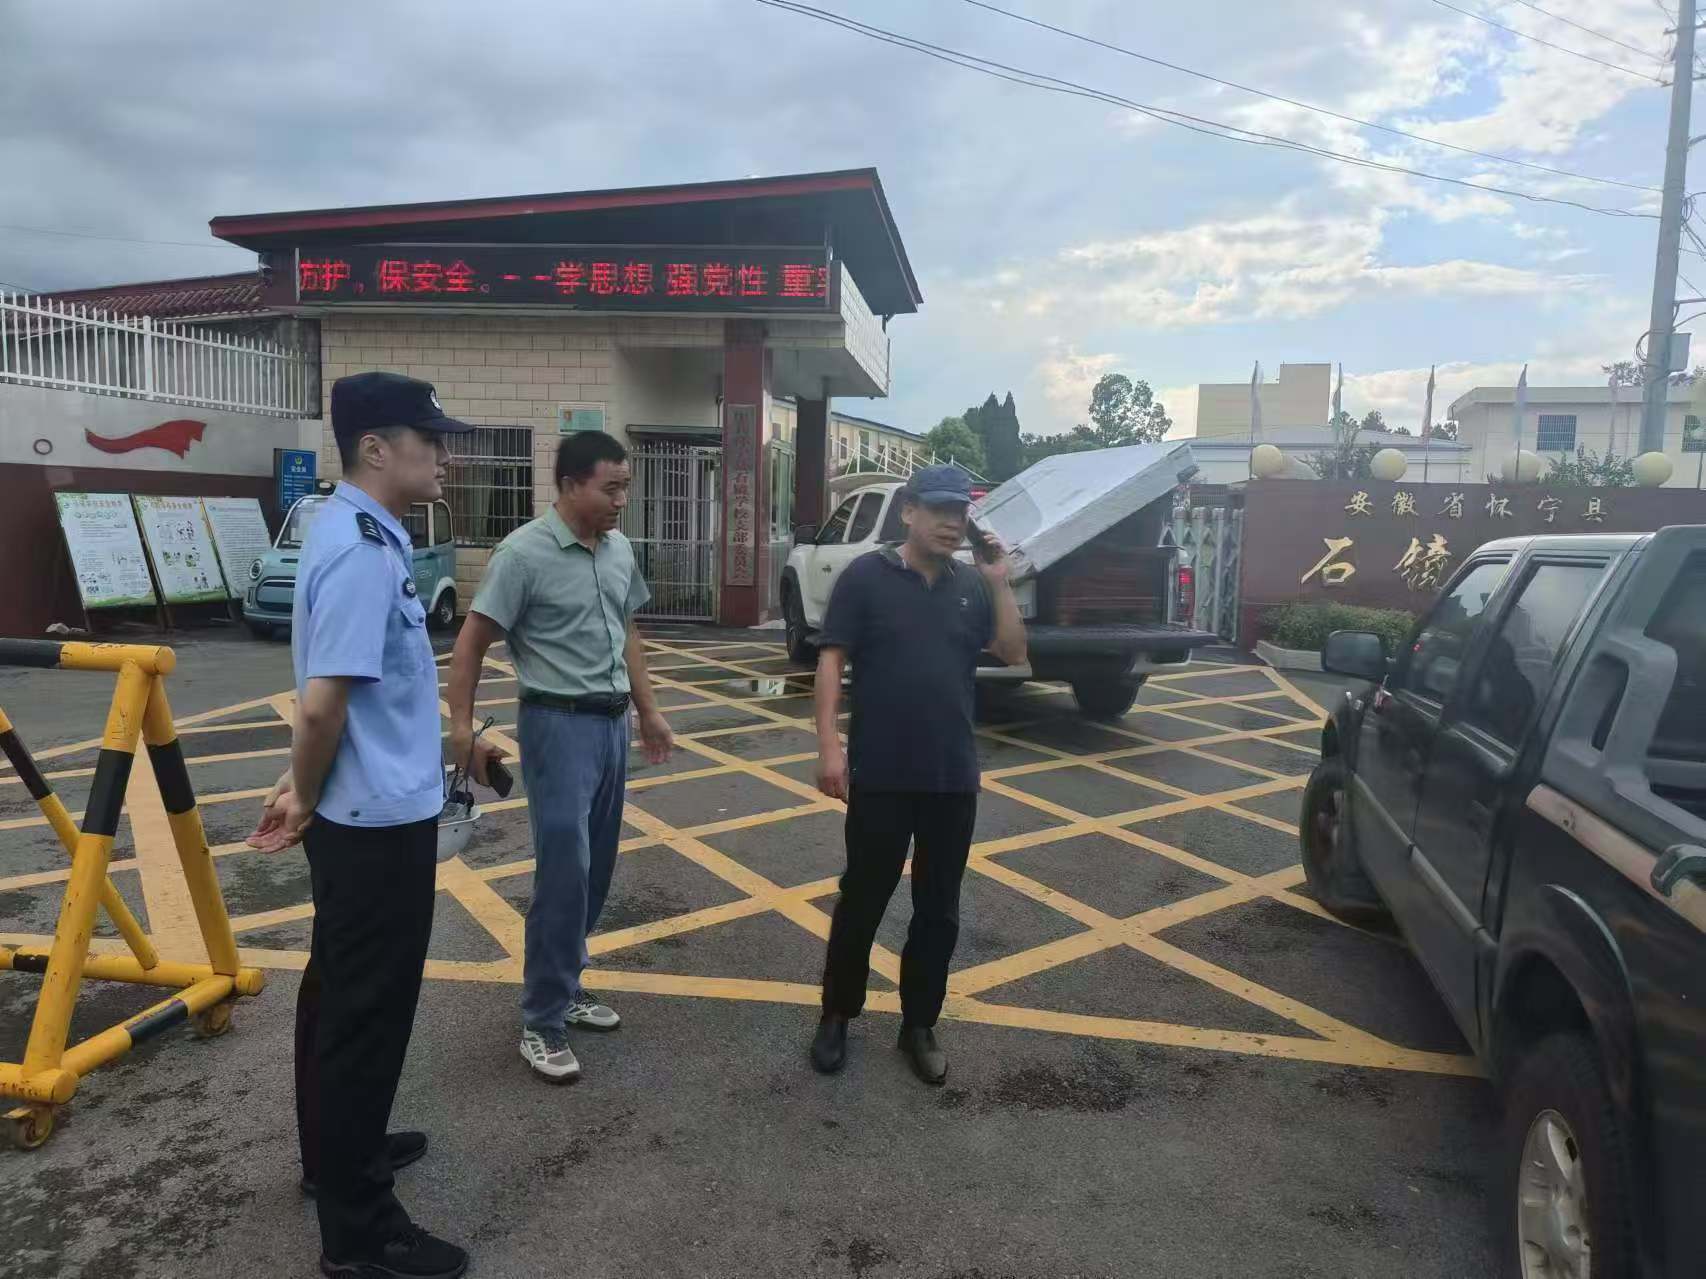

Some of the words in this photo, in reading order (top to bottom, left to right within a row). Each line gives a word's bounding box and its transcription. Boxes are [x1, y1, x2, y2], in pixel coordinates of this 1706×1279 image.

[664, 262, 769, 297] 强党性
[1344, 490, 1608, 524] 安徽省怀宁县
